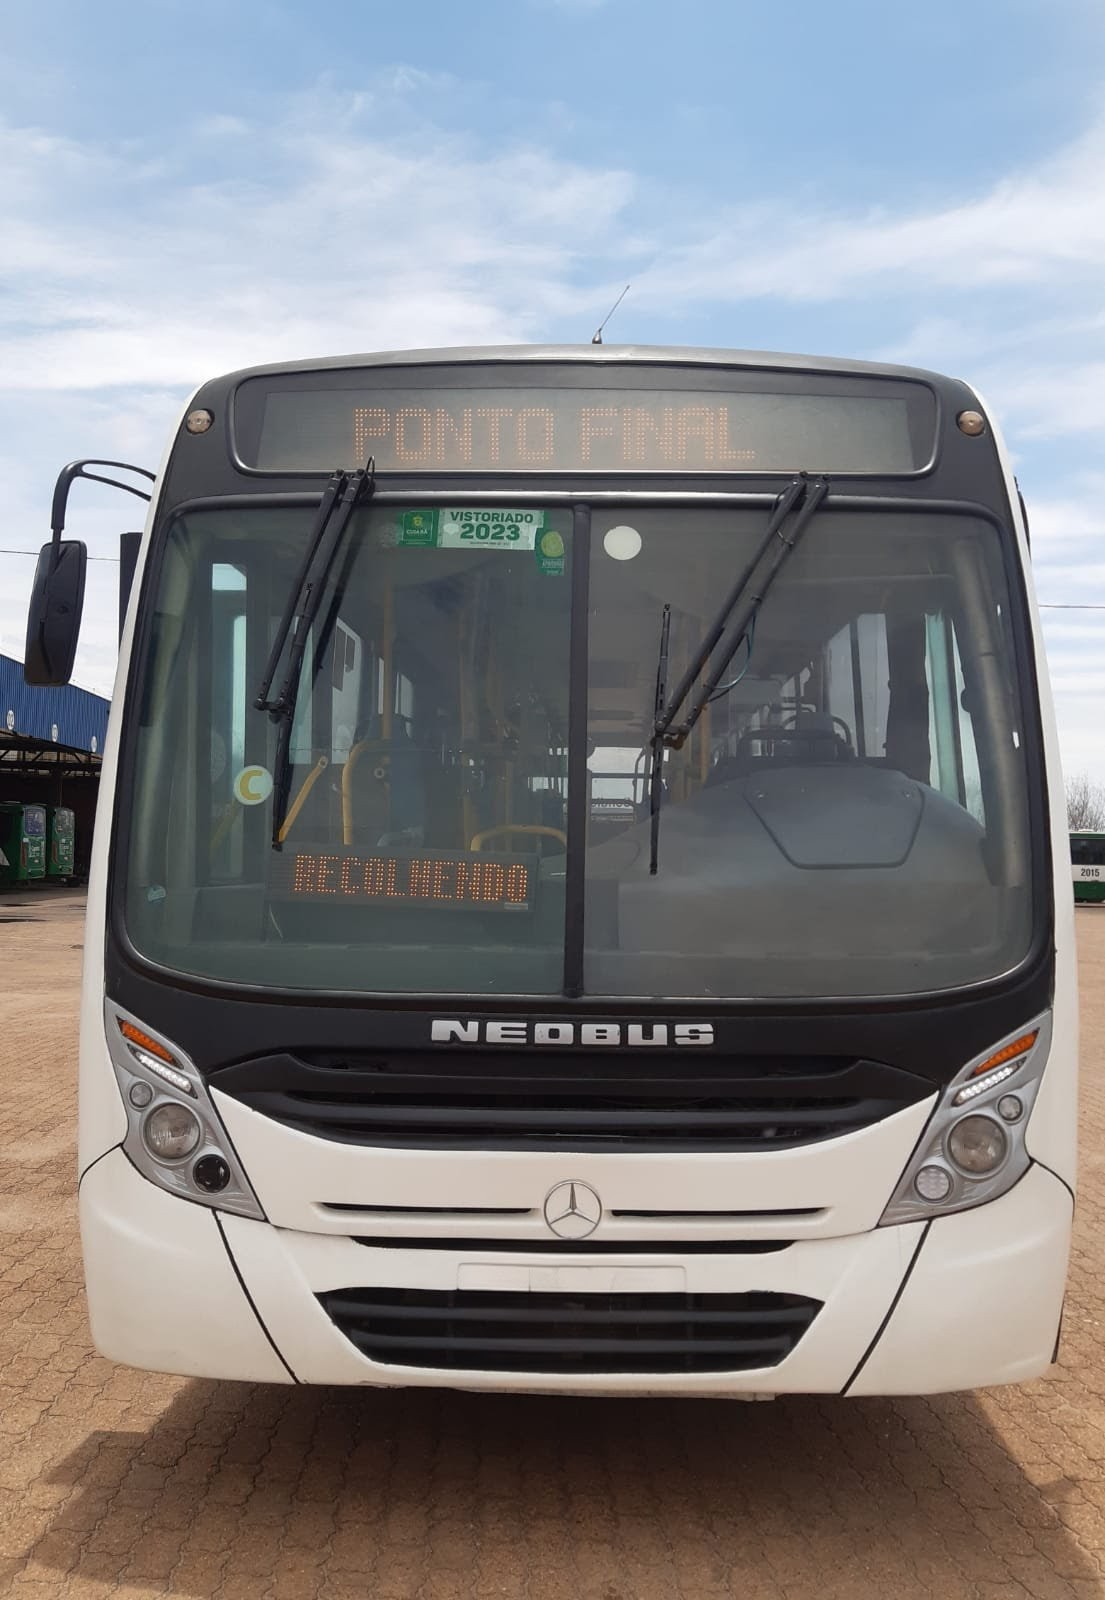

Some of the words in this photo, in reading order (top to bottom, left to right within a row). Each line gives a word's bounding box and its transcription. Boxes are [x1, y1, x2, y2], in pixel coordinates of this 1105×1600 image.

[353, 407, 554, 463] PONTO
[579, 406, 756, 461] FINAL
[450, 511, 534, 524] VISTORIADO
[460, 523, 521, 541] 2023
[239, 769, 263, 801] C
[294, 855, 528, 902] RECOLHENDO
[1080, 867, 1100, 878] 2015
[431, 1019, 714, 1046] NEOBUS
